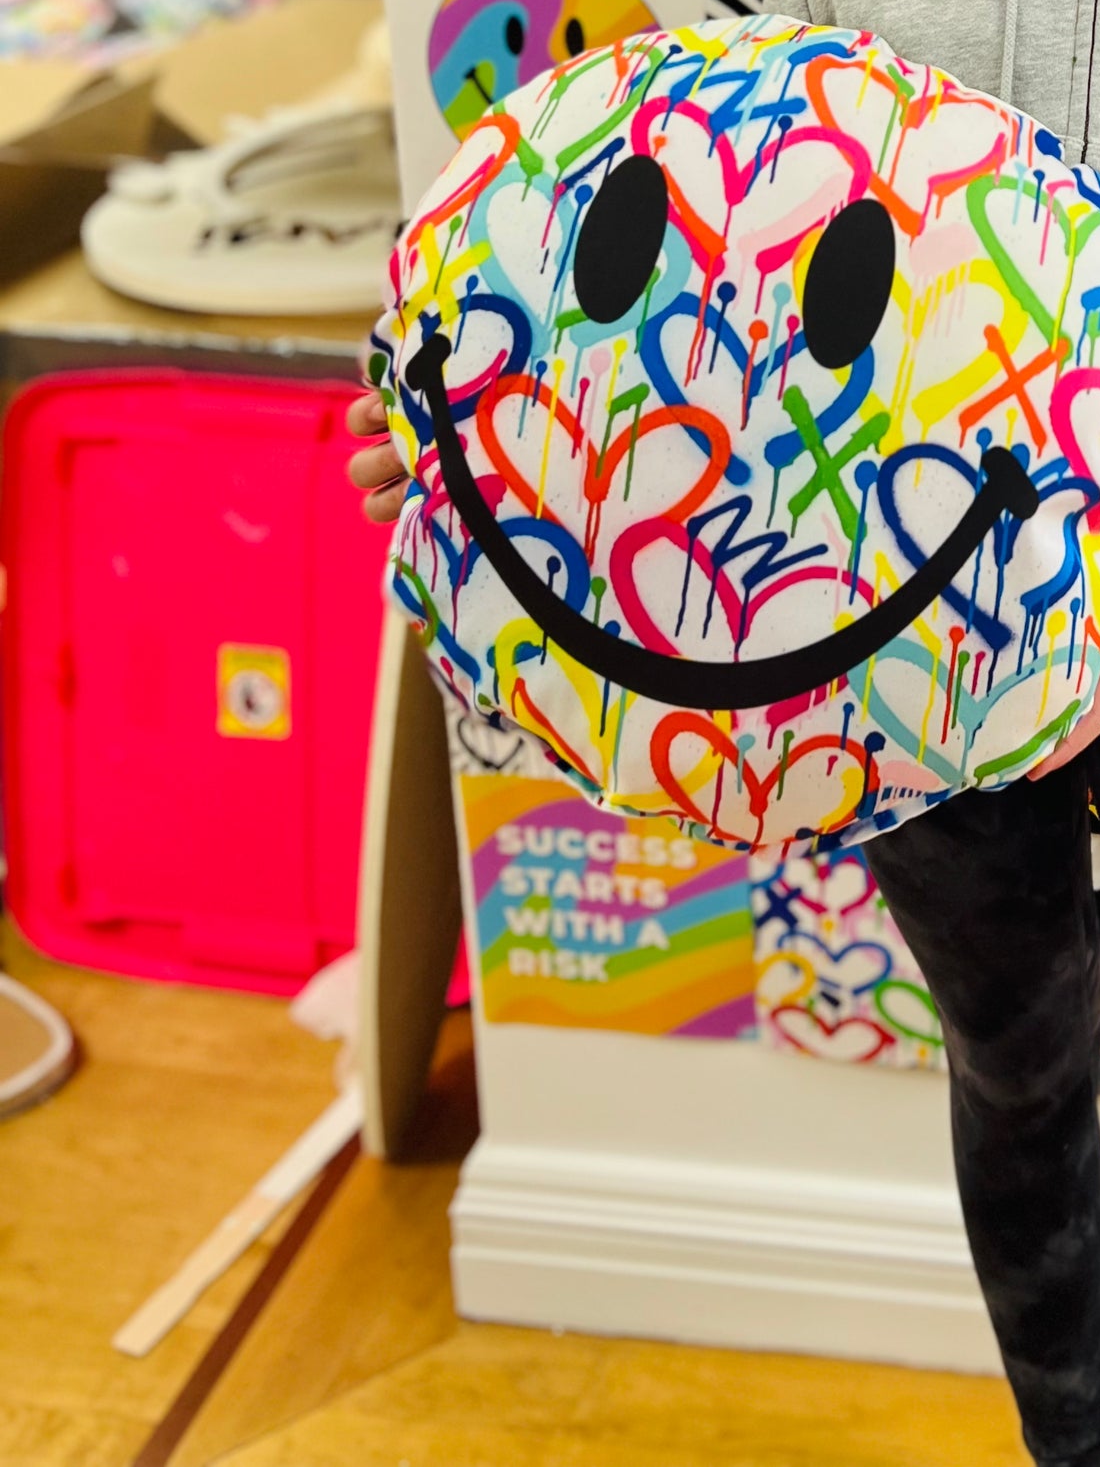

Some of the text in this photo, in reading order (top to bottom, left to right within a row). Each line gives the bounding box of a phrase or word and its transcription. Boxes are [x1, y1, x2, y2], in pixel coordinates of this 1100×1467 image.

[496, 824, 698, 870] SUCCESS
[500, 865, 669, 910] STARTS
[504, 905, 671, 951] WITH A
[507, 947, 611, 983] RISK
